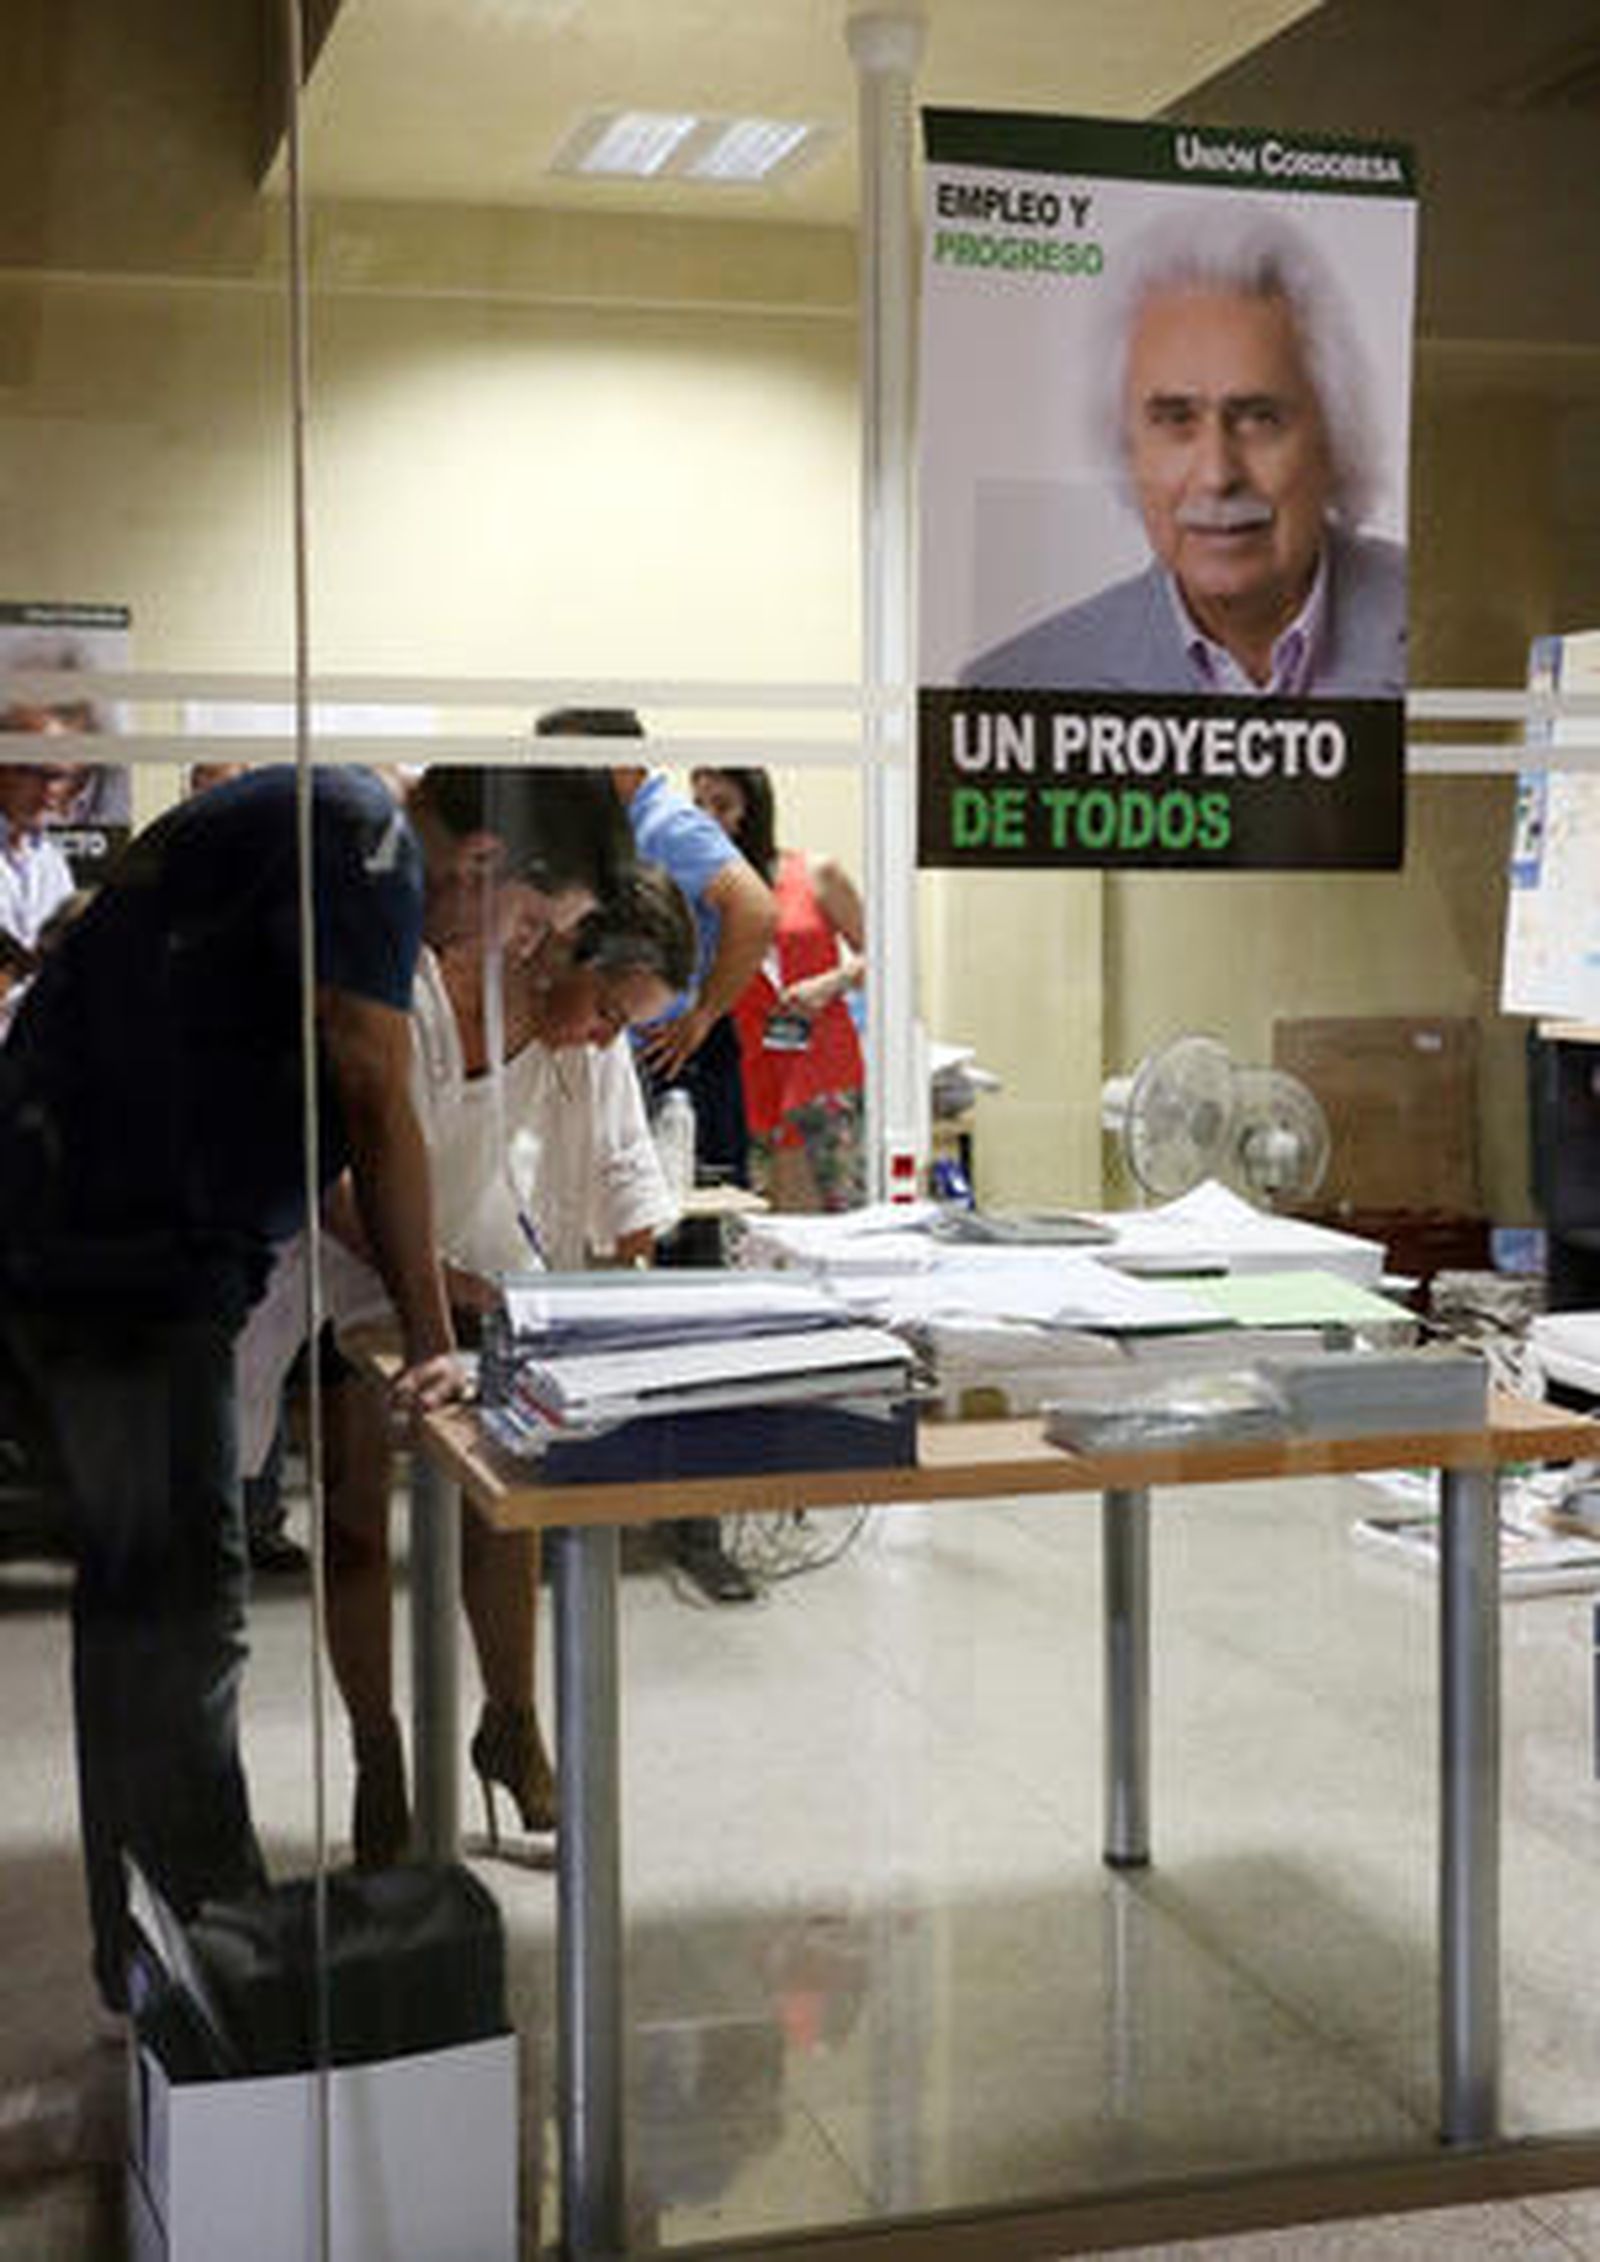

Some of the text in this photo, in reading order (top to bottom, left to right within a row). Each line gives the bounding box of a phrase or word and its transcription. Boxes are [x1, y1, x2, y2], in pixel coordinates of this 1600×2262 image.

[936, 183, 1091, 227] EMPLEO Y
[934, 231, 1103, 275] PROGRESO
[952, 713, 1346, 777] UN PROYECTO
[952, 788, 1232, 849] DE TODOS
